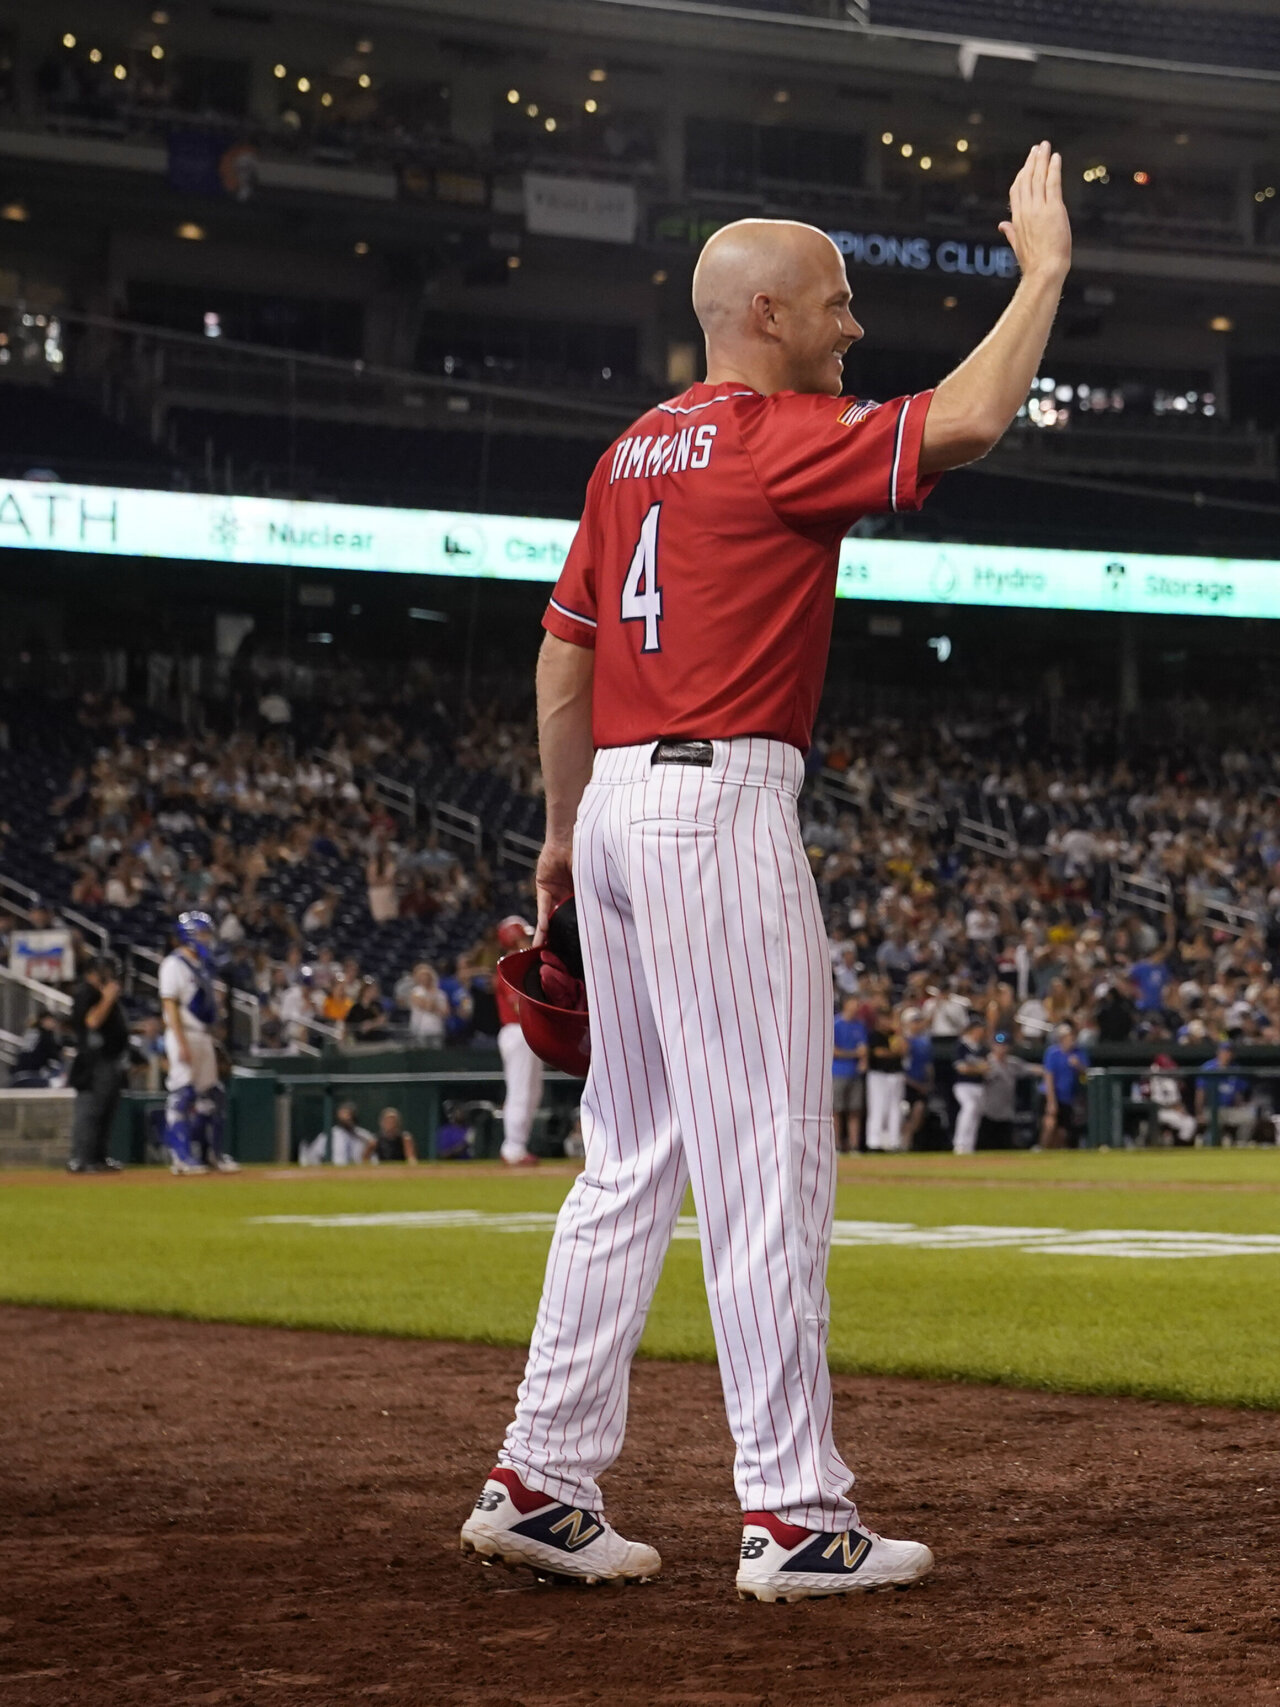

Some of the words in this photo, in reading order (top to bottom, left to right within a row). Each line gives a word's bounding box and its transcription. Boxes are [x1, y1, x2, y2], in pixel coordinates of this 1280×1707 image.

[828, 230, 931, 270] PIONS
[936, 240, 1019, 279] CLUB
[268, 521, 373, 549] Nuclear
[620, 501, 663, 654] 4
[841, 562, 868, 581] as
[974, 566, 1046, 592] Hydro
[1145, 575, 1234, 602] Storage
[549, 1509, 600, 1549] N
[822, 1531, 868, 1568] N
